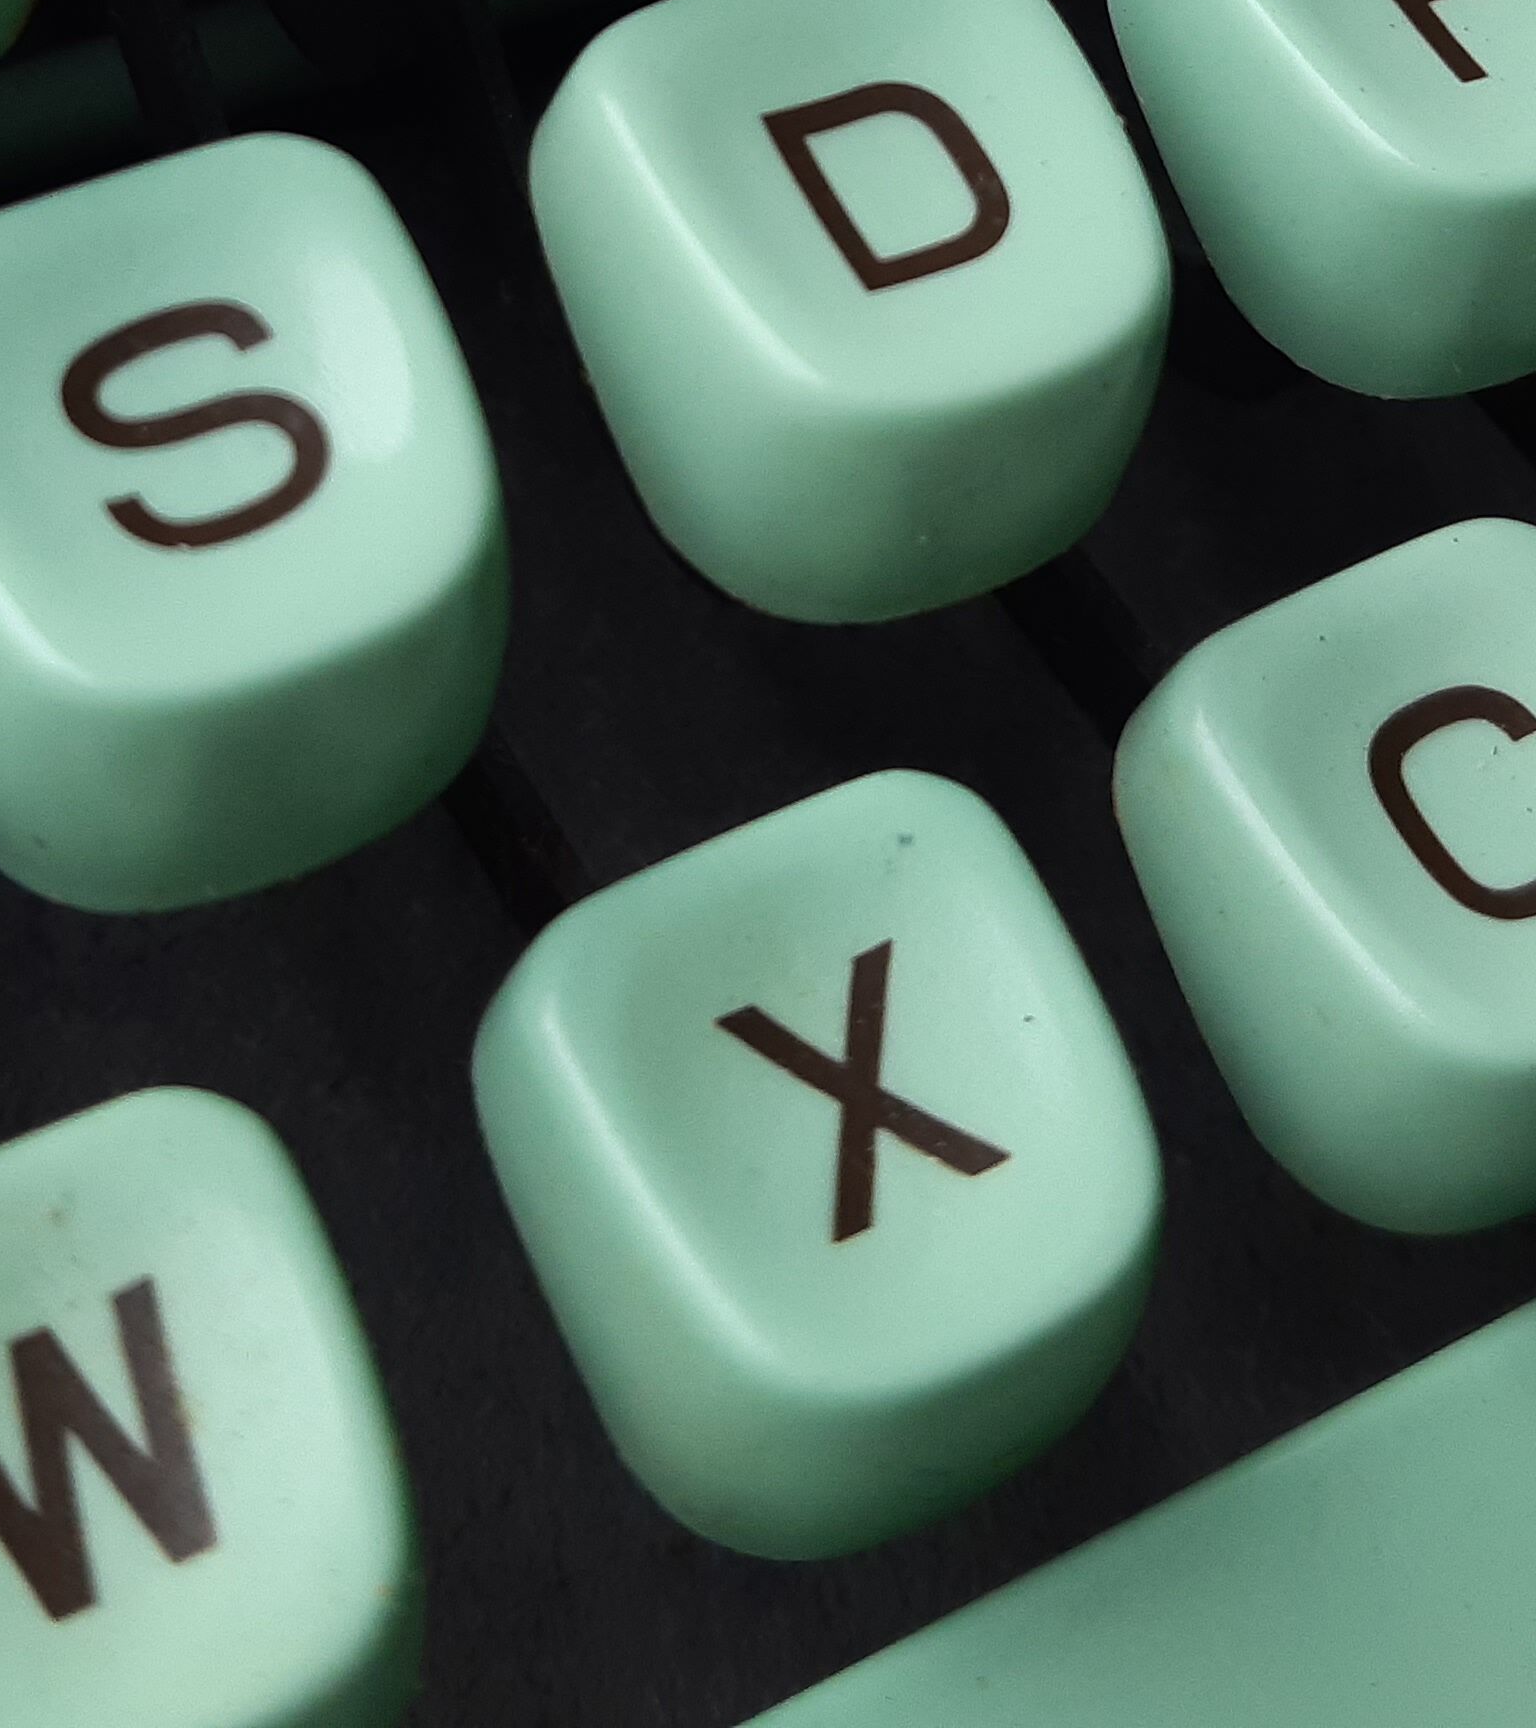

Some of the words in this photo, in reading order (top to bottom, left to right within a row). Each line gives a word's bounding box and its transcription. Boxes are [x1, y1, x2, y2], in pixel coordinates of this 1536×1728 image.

[761, 82, 1010, 291] D
[59, 302, 328, 549] S
[714, 941, 1008, 1242] X
